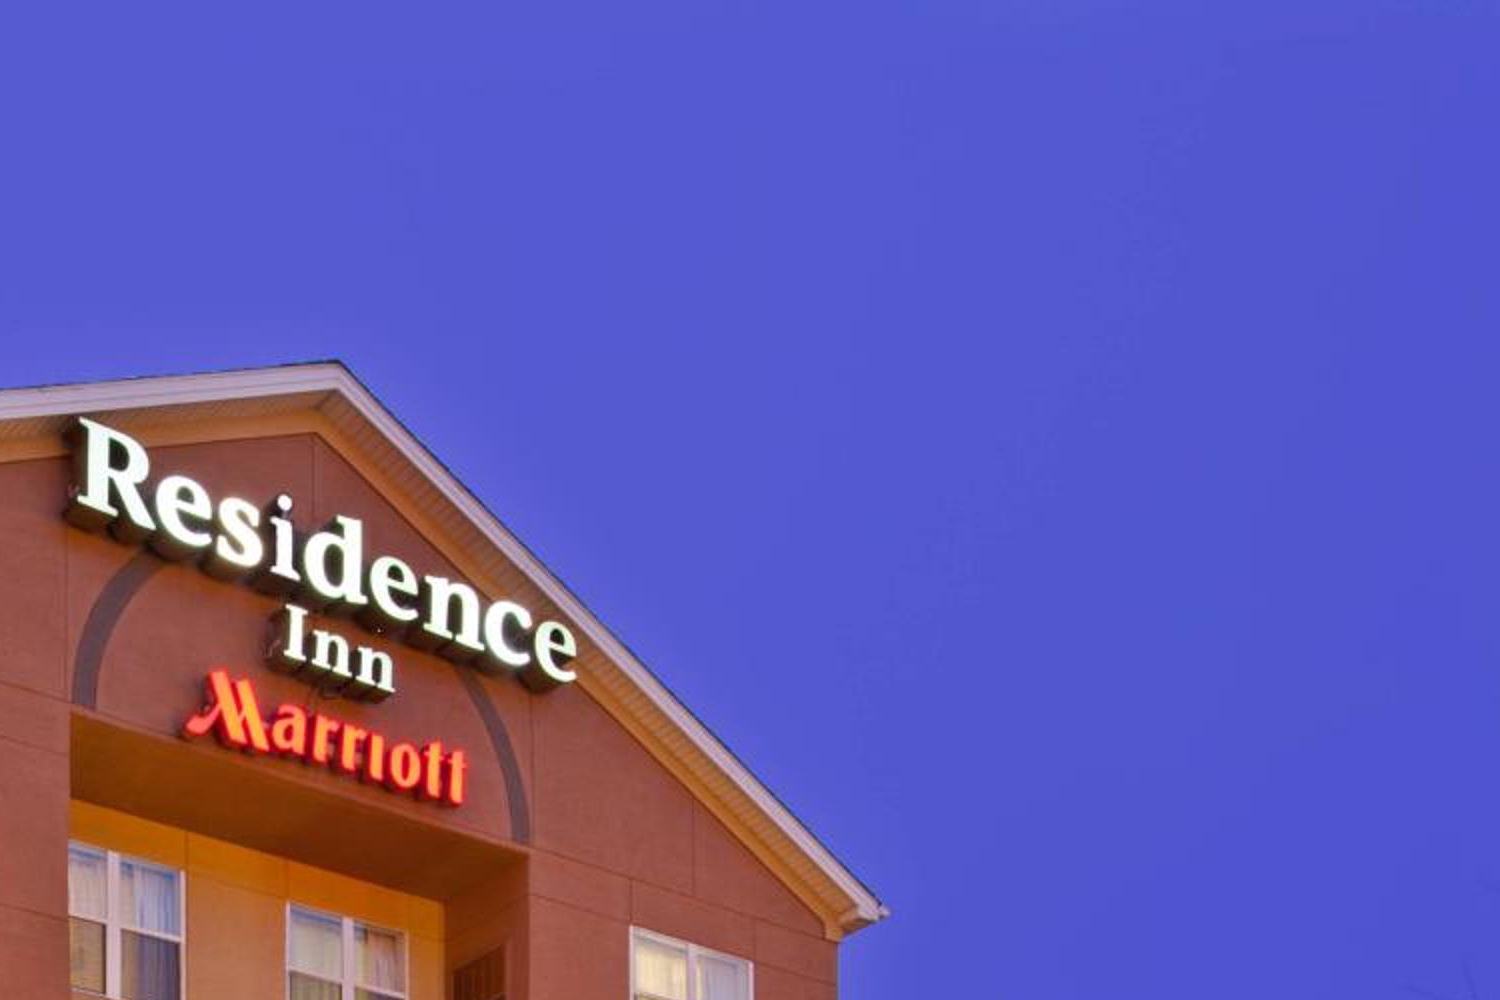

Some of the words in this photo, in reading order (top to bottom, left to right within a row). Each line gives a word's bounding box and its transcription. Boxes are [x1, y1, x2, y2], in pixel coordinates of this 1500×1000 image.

[77, 416, 578, 682] Residence
[283, 604, 396, 694] Inn
[185, 669, 468, 804] Marriott
